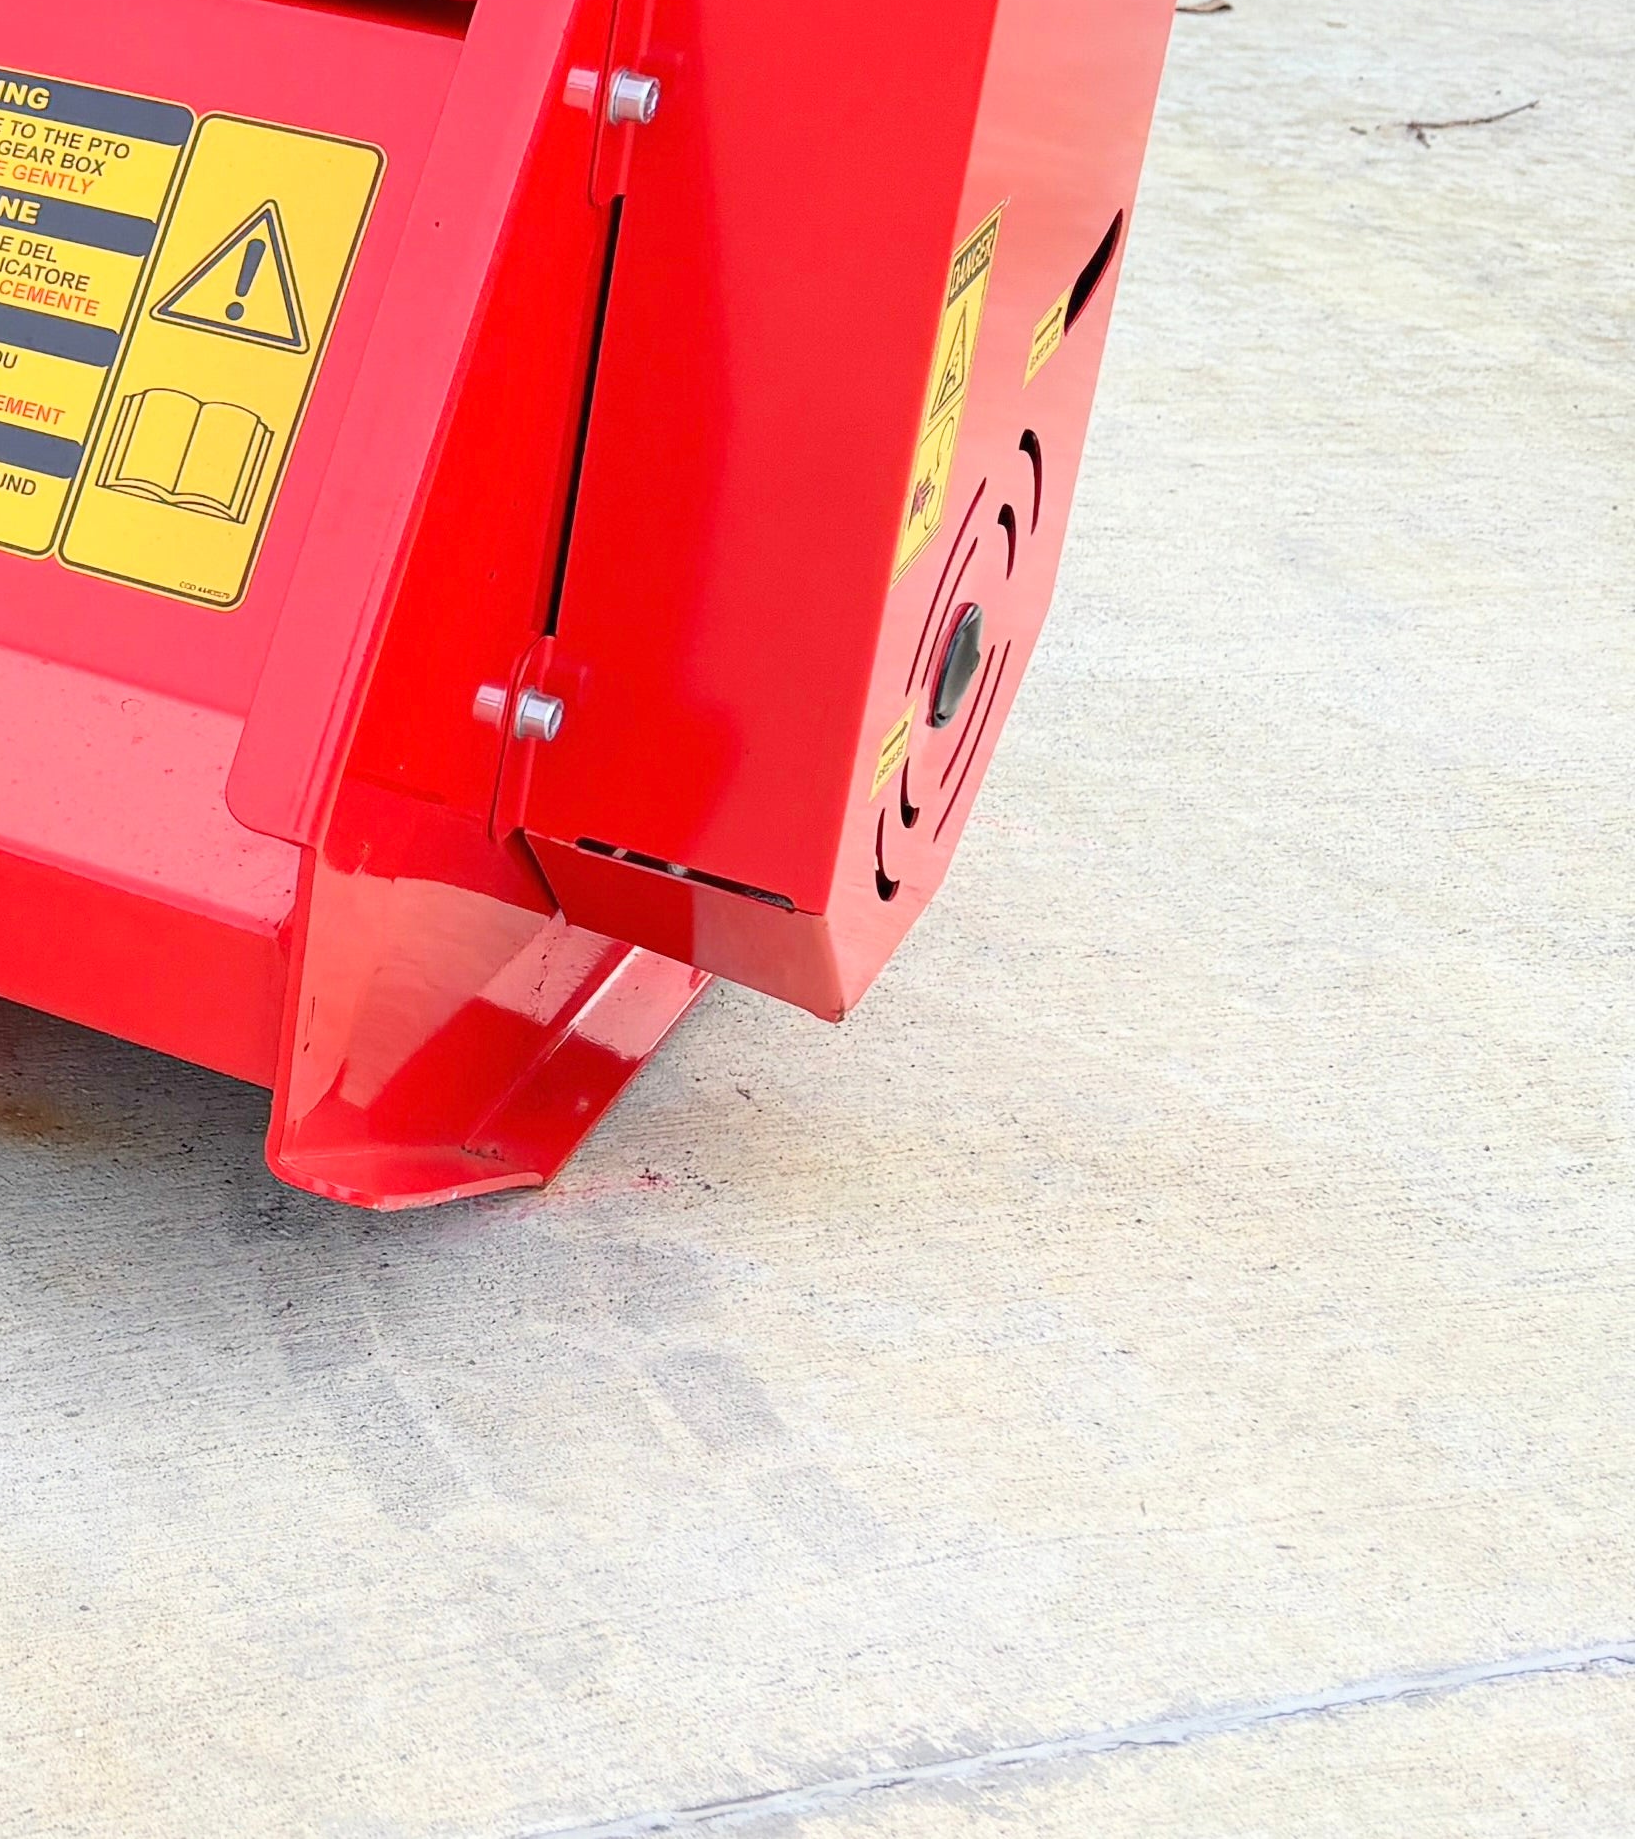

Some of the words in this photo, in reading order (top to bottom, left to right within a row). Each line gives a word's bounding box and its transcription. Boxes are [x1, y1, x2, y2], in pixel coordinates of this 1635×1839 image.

[11, 120, 36, 138] TO
[43, 127, 83, 149] THE
[88, 137, 130, 159] PTO
[60, 153, 106, 176] BOX
[12, 164, 95, 195] GENTLY
[18, 240, 57, 262] DEL
